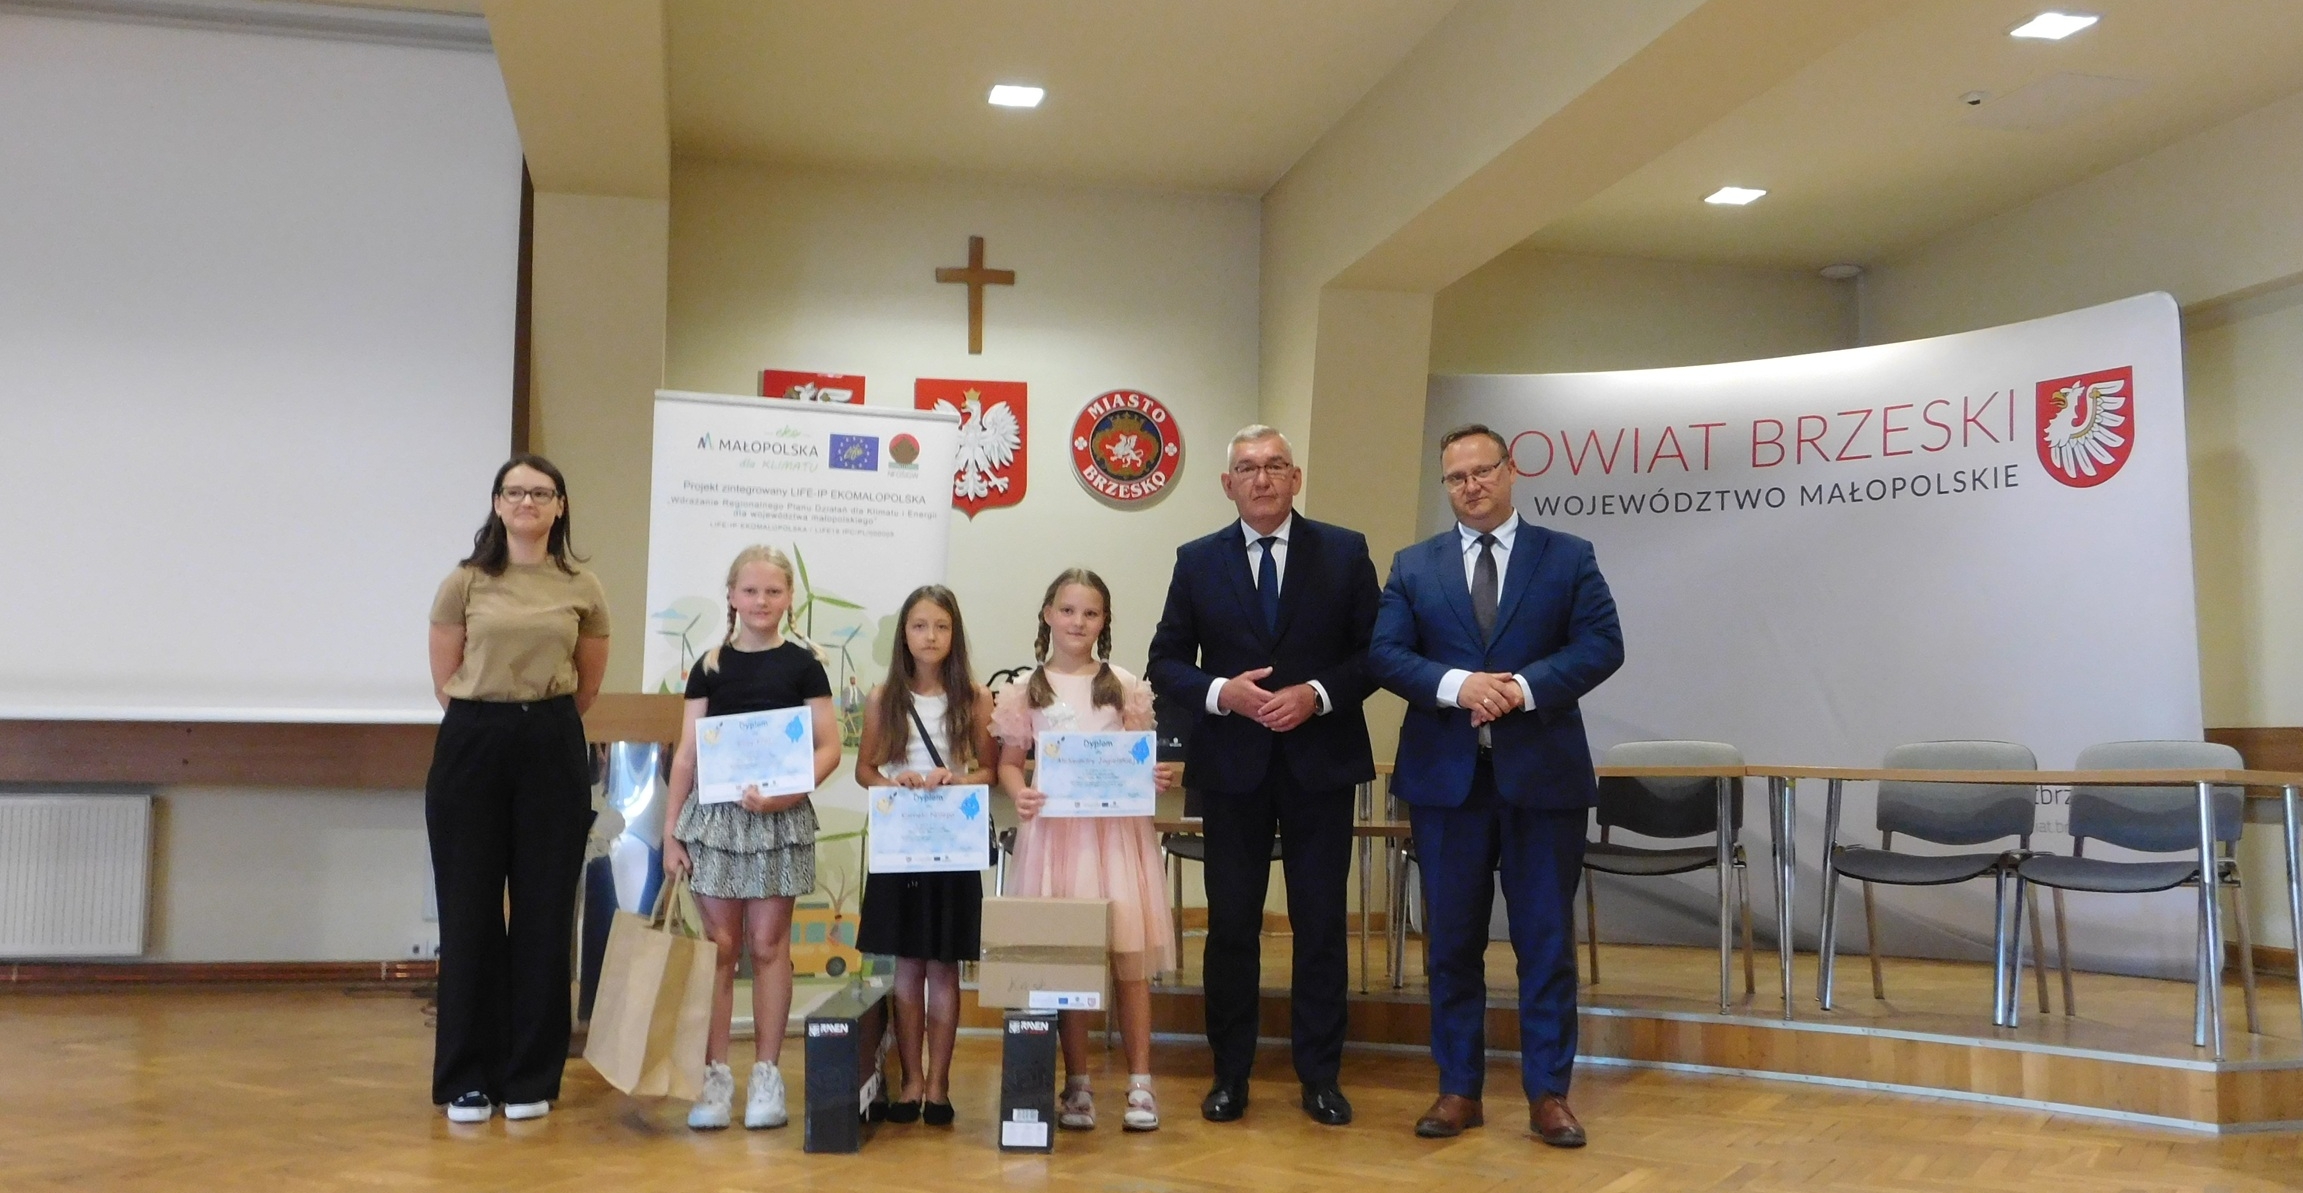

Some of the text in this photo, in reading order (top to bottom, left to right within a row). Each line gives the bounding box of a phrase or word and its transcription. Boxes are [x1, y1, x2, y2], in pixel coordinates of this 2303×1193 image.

[1087, 393, 1166, 423] MIASTO
[1509, 388, 2015, 478] OWIAT BRZESKI
[718, 438, 819, 457] MAŁOPOLSKA
[762, 460, 818, 473] KLIMATU
[683, 479, 719, 494] Projekt
[722, 484, 788, 498] zintegrowany
[791, 486, 828, 499] LIFE-IP
[1082, 464, 1166, 499] BRZESKO
[1534, 464, 2019, 516] WOJEWÓDZTWO MAŁOPOLSKIE
[722, 499, 784, 511] Regionalnego
[787, 501, 811, 512] Planu
[867, 507, 899, 518] Klimatu
[907, 509, 937, 521] Energii
[750, 510, 808, 522] województwa
[739, 720, 769, 730] Dyplom
[1083, 739, 1113, 749] Dyplom
[913, 792, 944, 803] Dyplom
